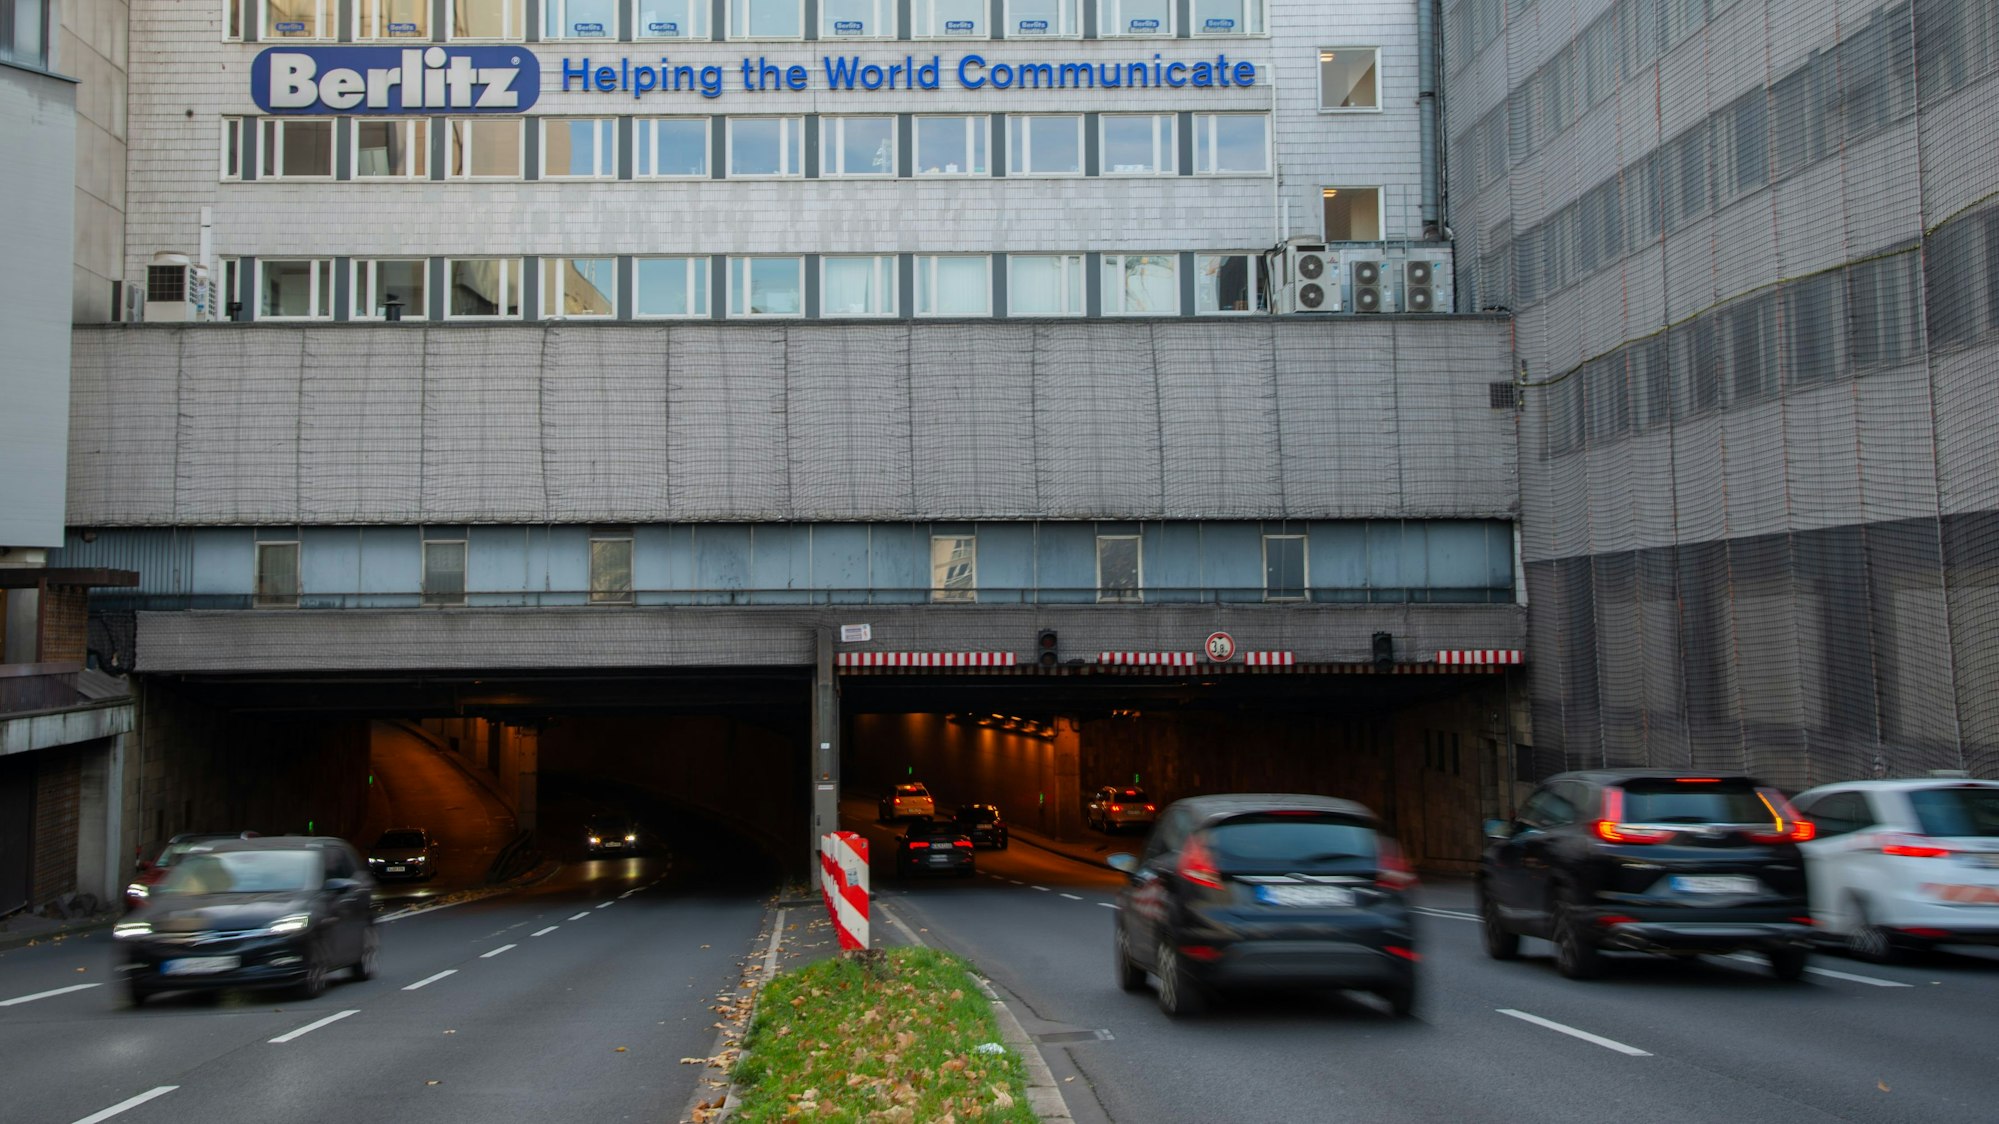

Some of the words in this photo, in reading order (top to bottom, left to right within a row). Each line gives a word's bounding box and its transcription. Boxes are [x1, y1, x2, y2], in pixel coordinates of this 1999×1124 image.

[562, 57, 722, 98] Helping
[741, 56, 808, 91] the
[824, 55, 940, 90] World
[958, 53, 1255, 89] Communicate
